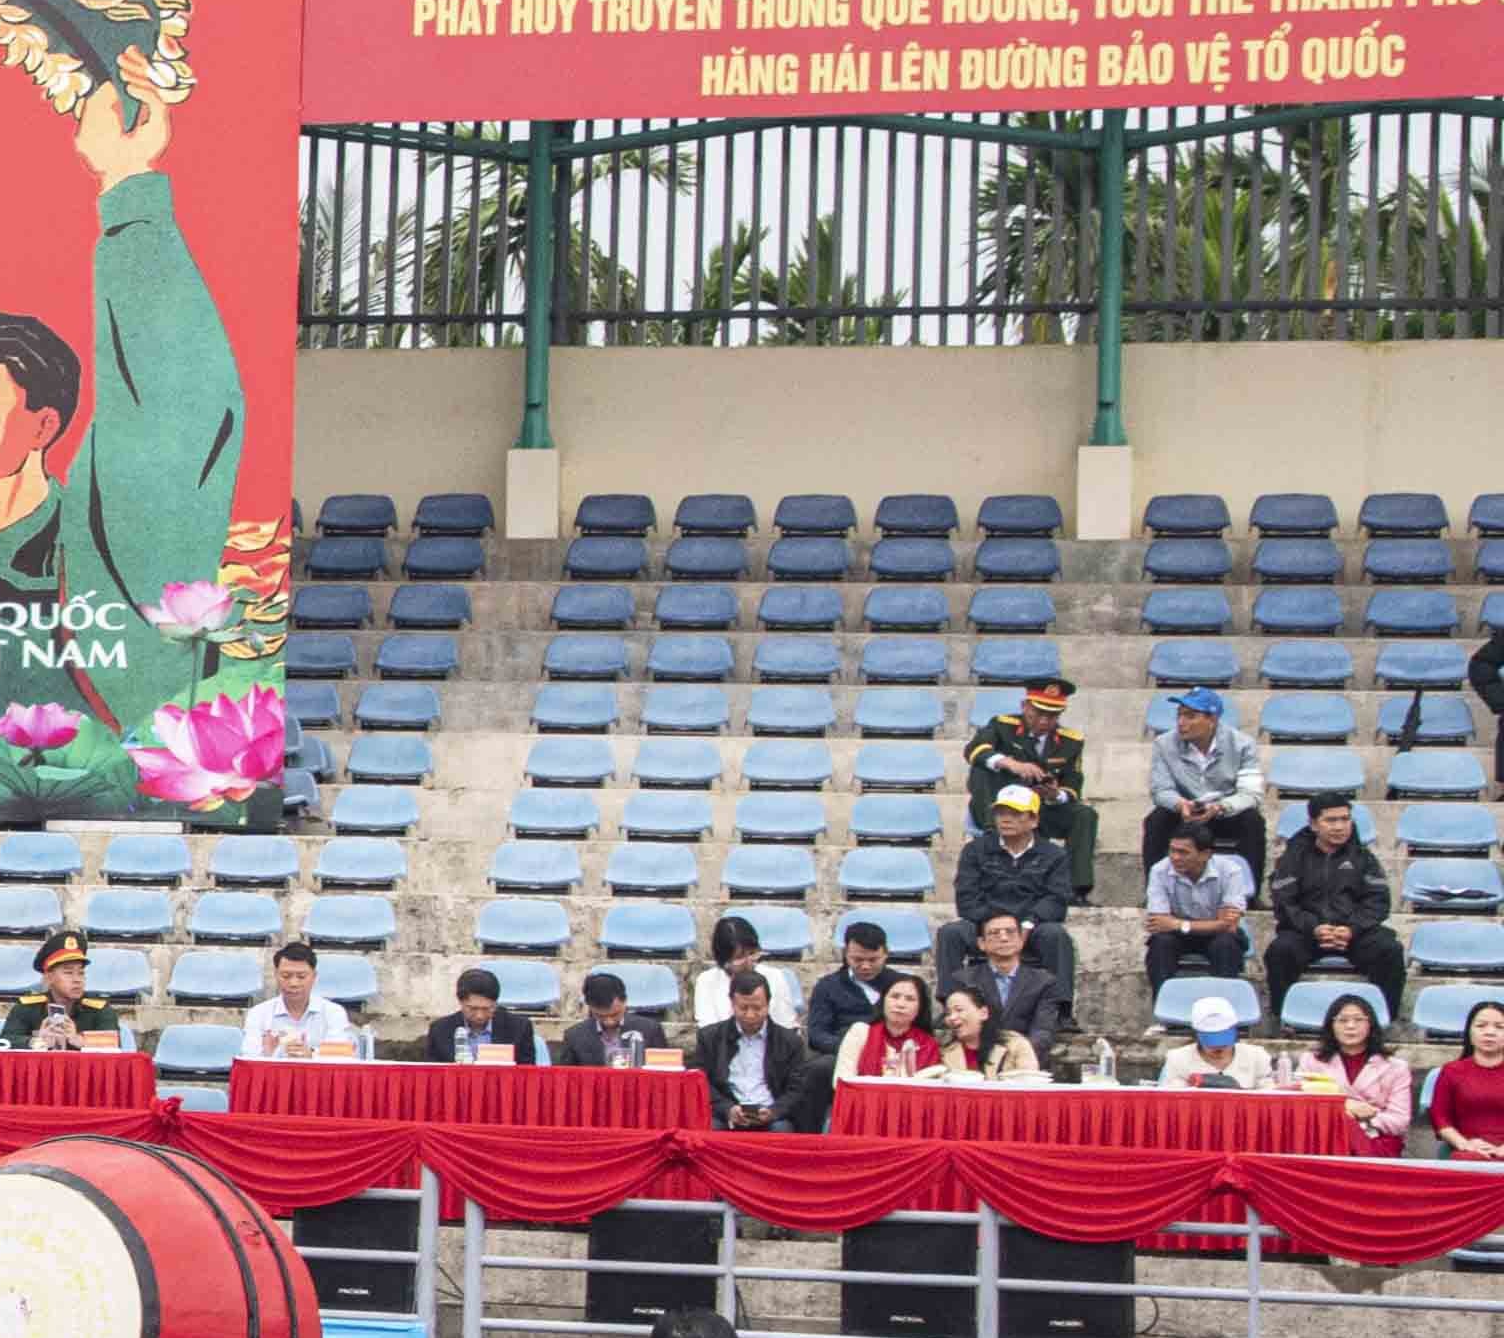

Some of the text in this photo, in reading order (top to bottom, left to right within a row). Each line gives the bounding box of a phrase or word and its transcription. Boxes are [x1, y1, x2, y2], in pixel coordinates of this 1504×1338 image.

[701, 20, 1406, 96] HĂNG HÁI LÊN ĐƯỜNG BẢO VỆ TỔ QUỐC
[22, 639, 129, 670] NAM
